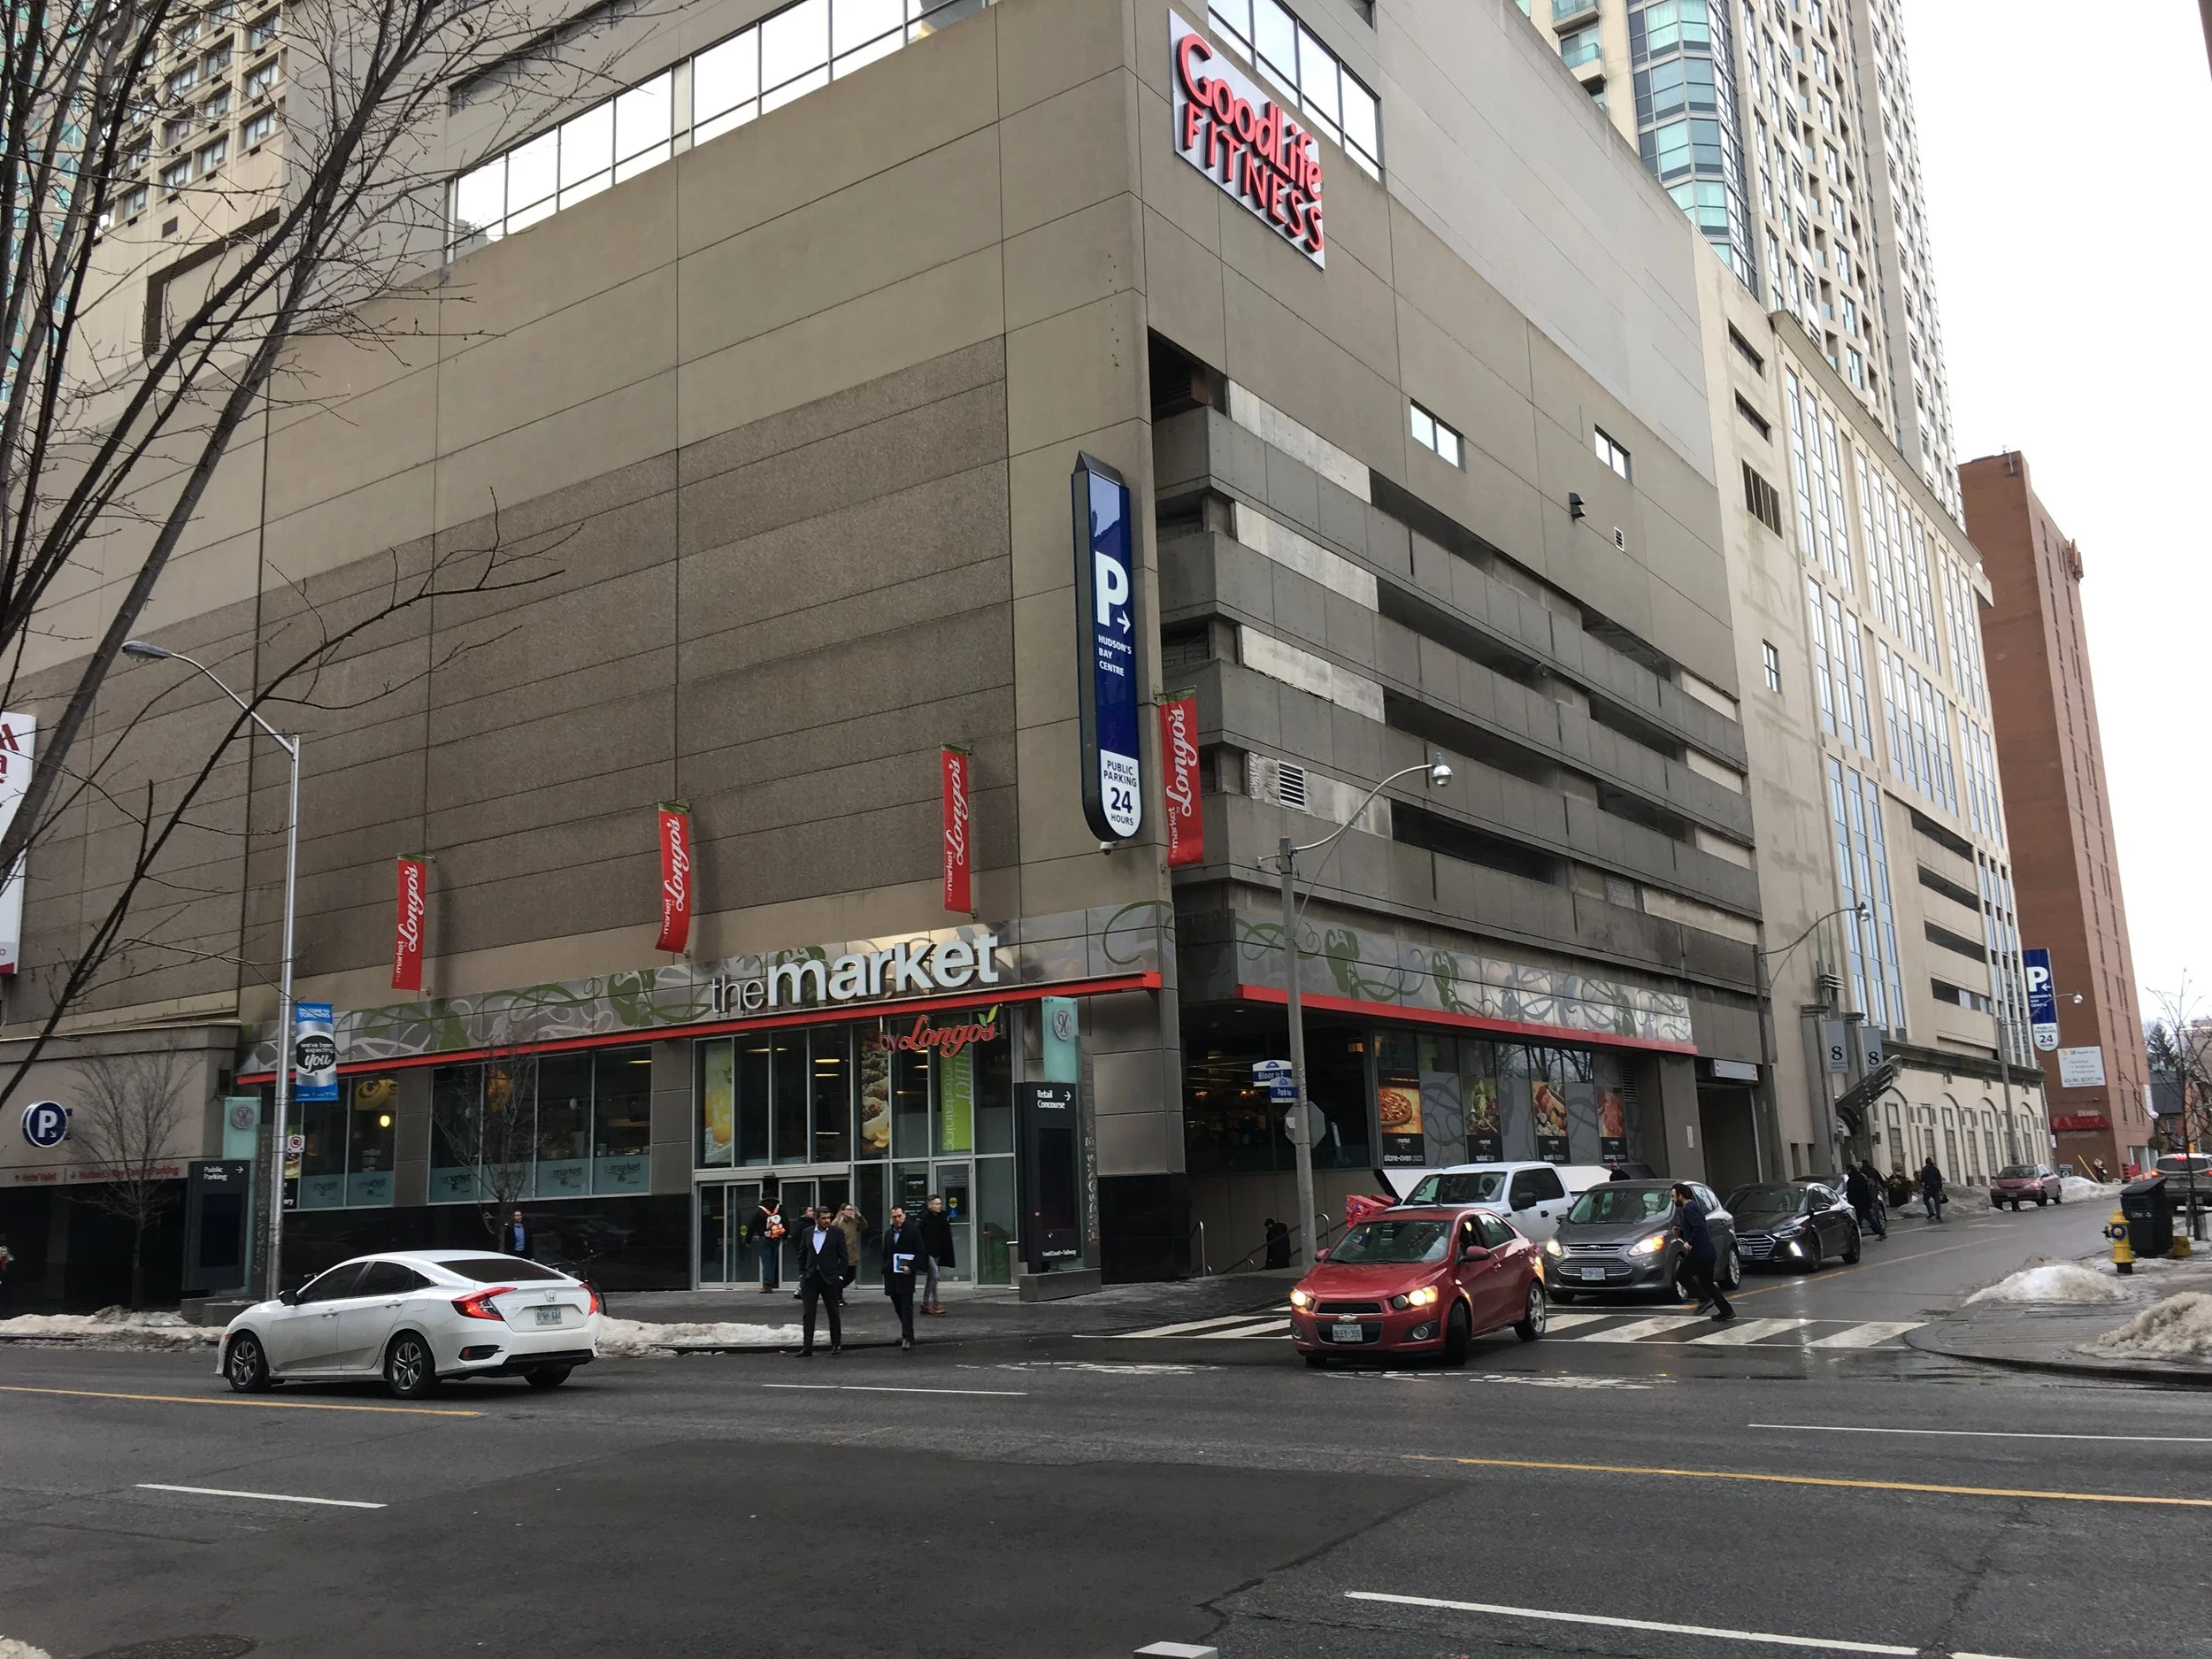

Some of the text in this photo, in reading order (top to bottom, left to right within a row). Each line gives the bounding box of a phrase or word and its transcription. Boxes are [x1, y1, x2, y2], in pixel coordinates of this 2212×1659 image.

[1176, 34, 1323, 203] GoodLife
[1182, 102, 1324, 253] FITNESS
[1095, 551, 1128, 626] P
[1098, 634, 1132, 655] HUDSON'S
[1098, 648, 1112, 660] BAY
[1099, 660, 1125, 677] CENTRE
[1107, 760, 1133, 776] PUBLIC
[1166, 704, 1197, 817] Longo's
[1103, 770, 1137, 787] PARKING
[1110, 787, 1133, 814] 24
[946, 757, 968, 866] Longo's
[1110, 813, 1133, 826] HOURS
[1168, 806, 1179, 849] market
[664, 817, 689, 912] Longo's
[398, 864, 425, 952] Longo's
[710, 932, 999, 1014] the market
[2026, 966, 2048, 992] P
[879, 1032, 900, 1054] by
[2039, 1034, 2054, 1043] 24
[304, 1054, 332, 1071] you
[1832, 1046, 1843, 1060] 8
[1868, 1051, 1879, 1065] 8
[1258, 1071, 1274, 1080] Bloor
[1037, 1089, 1053, 1099] Retail
[1037, 1099, 1065, 1109] Concourse
[37, 1110, 58, 1138] P
[204, 1173, 228, 1182] Parking
